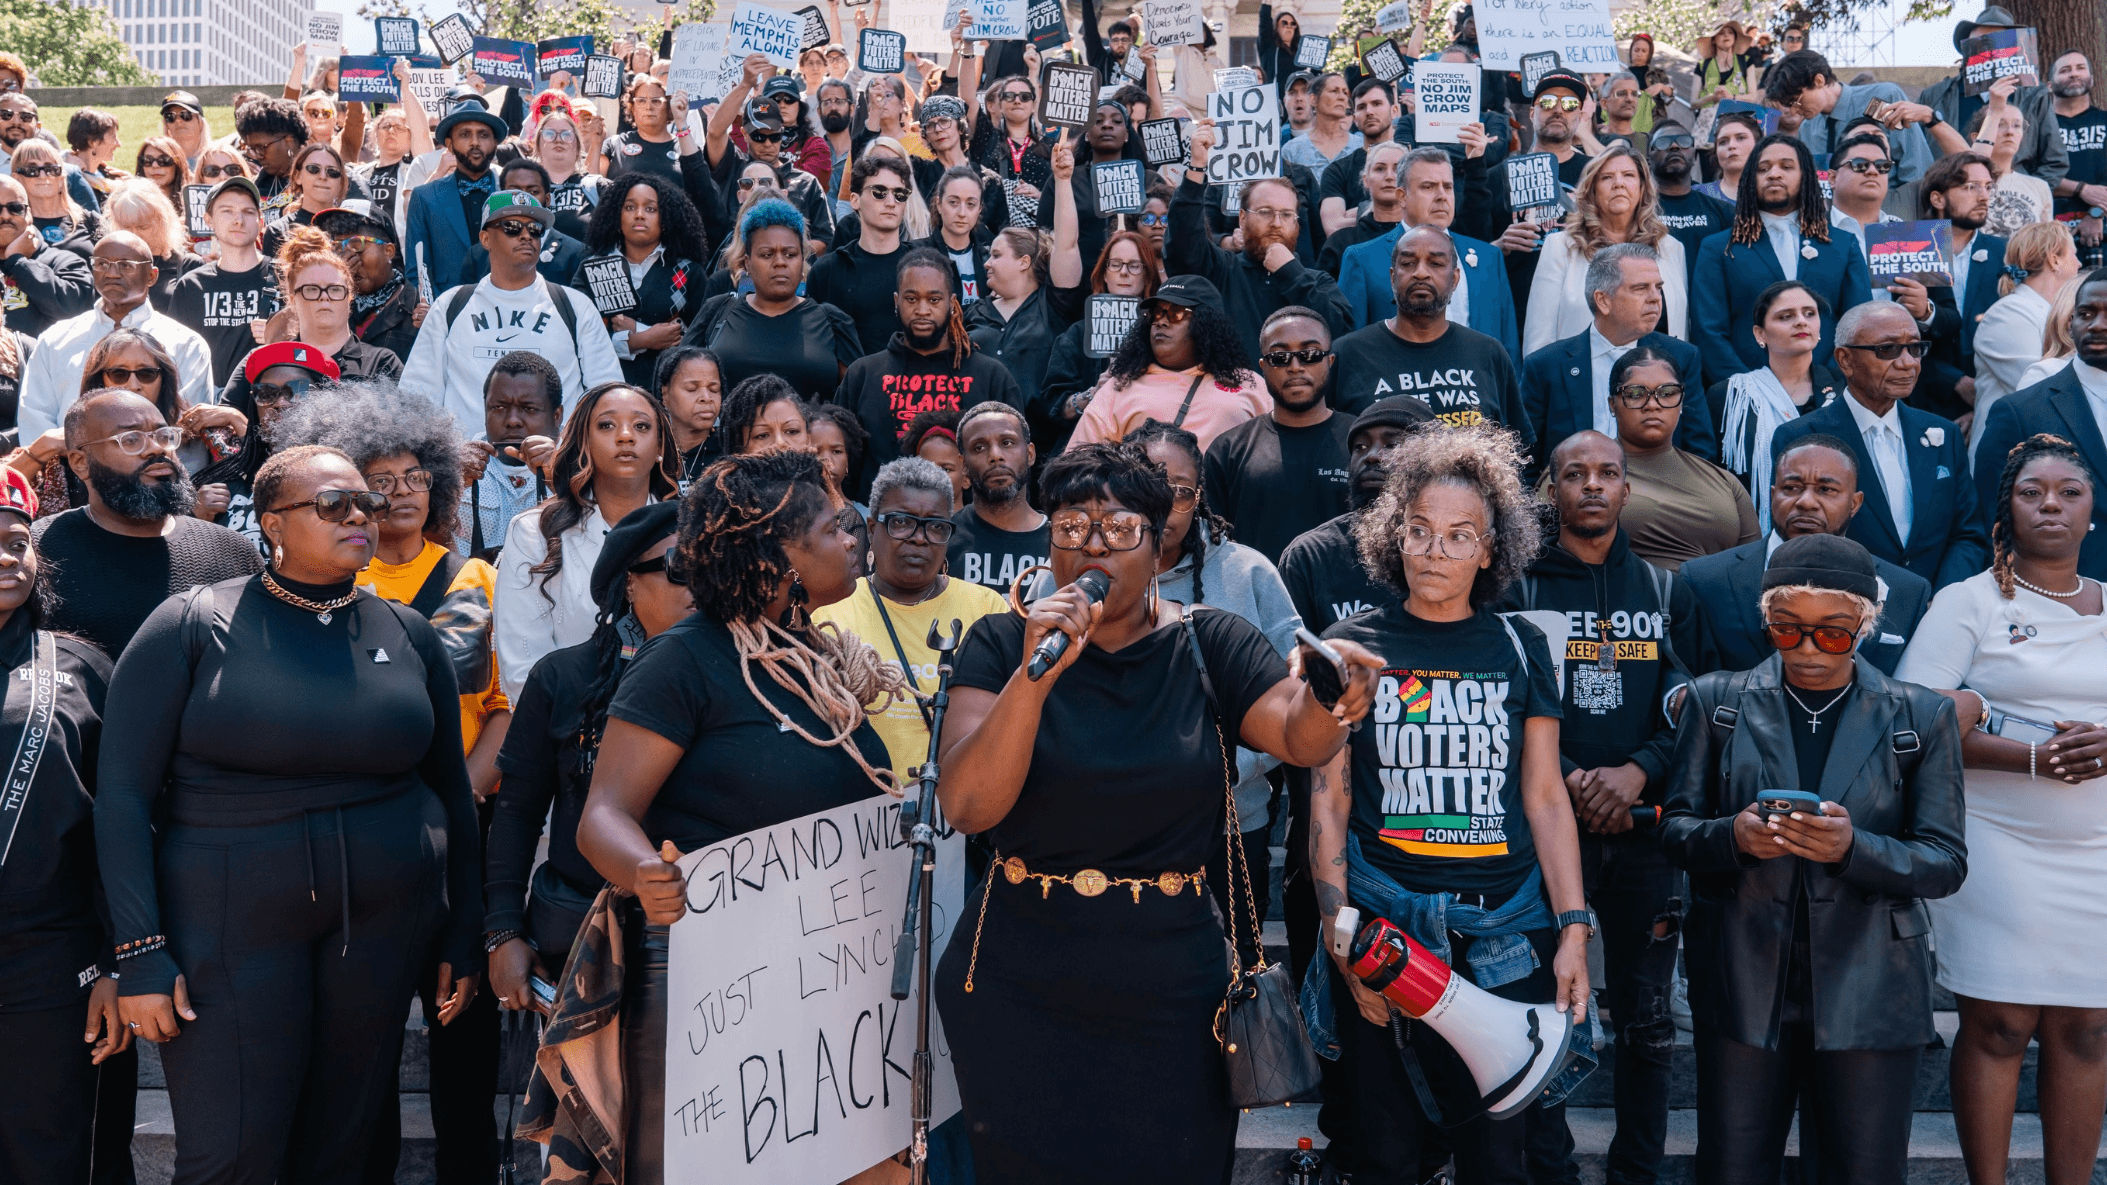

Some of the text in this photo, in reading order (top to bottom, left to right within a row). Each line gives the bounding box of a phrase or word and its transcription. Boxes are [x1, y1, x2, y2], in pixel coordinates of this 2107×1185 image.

[984, 4, 1005, 15] NO
[1040, 3, 1058, 14] OUR
[1146, 2, 1192, 17] Democracy
[1560, 0, 1598, 12] action
[748, 10, 796, 34] LEAVE
[1028, 10, 1061, 32] VOTE
[1148, 14, 1196, 30] Needs Your
[309, 28, 338, 36] CROW
[310, 34, 337, 42] MAPS
[382, 32, 414, 42] VOTERS
[732, 22, 800, 48] MEMPHIS
[969, 24, 1022, 36] JIM CROW
[1150, 30, 1194, 46] Courage
[1485, 24, 1613, 38] there is an EQUAL
[382, 41, 415, 51] MATTER
[741, 37, 794, 60] ALONE
[864, 45, 900, 58] VOTERS
[1300, 46, 1328, 58] VOTERS
[541, 54, 583, 67] PROTECT
[863, 56, 900, 69] MATTER
[1298, 55, 1324, 66] MATTER
[1566, 46, 1618, 64] REACTION
[474, 57, 522, 71] PROTECT
[541, 60, 585, 72] THE SOUT
[1966, 56, 2025, 75] PROTECT
[429, 73, 445, 84] LEE
[474, 66, 532, 80] THE SOUTH
[586, 70, 618, 84] VOTERS
[1966, 65, 2036, 84] THE SOUTH
[340, 77, 388, 86] PROTECT
[340, 84, 398, 94] THE SOUTH
[585, 81, 616, 95] MATTER
[1421, 84, 1472, 93] NO JIM
[1048, 86, 1091, 107] VOTERS
[1216, 88, 1264, 116] NO
[1422, 94, 1471, 103] CROW
[1045, 102, 1090, 122] MATTER
[1425, 104, 1470, 113] MAPS
[1144, 133, 1179, 150] VOTERS
[1214, 118, 1272, 150] JIM
[1147, 145, 1181, 162] MATTER
[1208, 150, 1279, 181] CROW
[1098, 179, 1139, 198] VOTERS
[1509, 171, 1554, 191] VOTERS
[1099, 193, 1141, 212] MATTER
[1510, 184, 1554, 206] MATTER
[1870, 251, 1936, 265] PROTECT
[1870, 262, 1949, 275] THE SOUTH
[590, 276, 632, 298] VOTERS
[203, 292, 232, 317] 1/3
[594, 291, 637, 312] MATTER
[204, 318, 230, 326] STOP THE
[471, 306, 551, 334] NIKE
[882, 374, 974, 393] PROTECT
[1374, 369, 1477, 396] A BLACK
[890, 392, 961, 412] BLACK
[1436, 390, 1480, 408] WAS
[1318, 468, 1350, 478] Los Ang
[1566, 642, 1648, 658] KEEP SAFE
[1429, 670, 1461, 679] MATTER.
[4, 668, 50, 811] THE MARC JACOBS
[1375, 723, 1510, 770] VOTERS
[1378, 768, 1506, 815] MATTER
[1471, 816, 1503, 829] STATE
[1424, 829, 1507, 843] CONVENING
[685, 818, 842, 914] GRAND
[798, 870, 882, 936] LEE
[688, 966, 768, 1055] JUST
[674, 1084, 725, 1136] THE
[739, 1000, 912, 1164] BLACK
